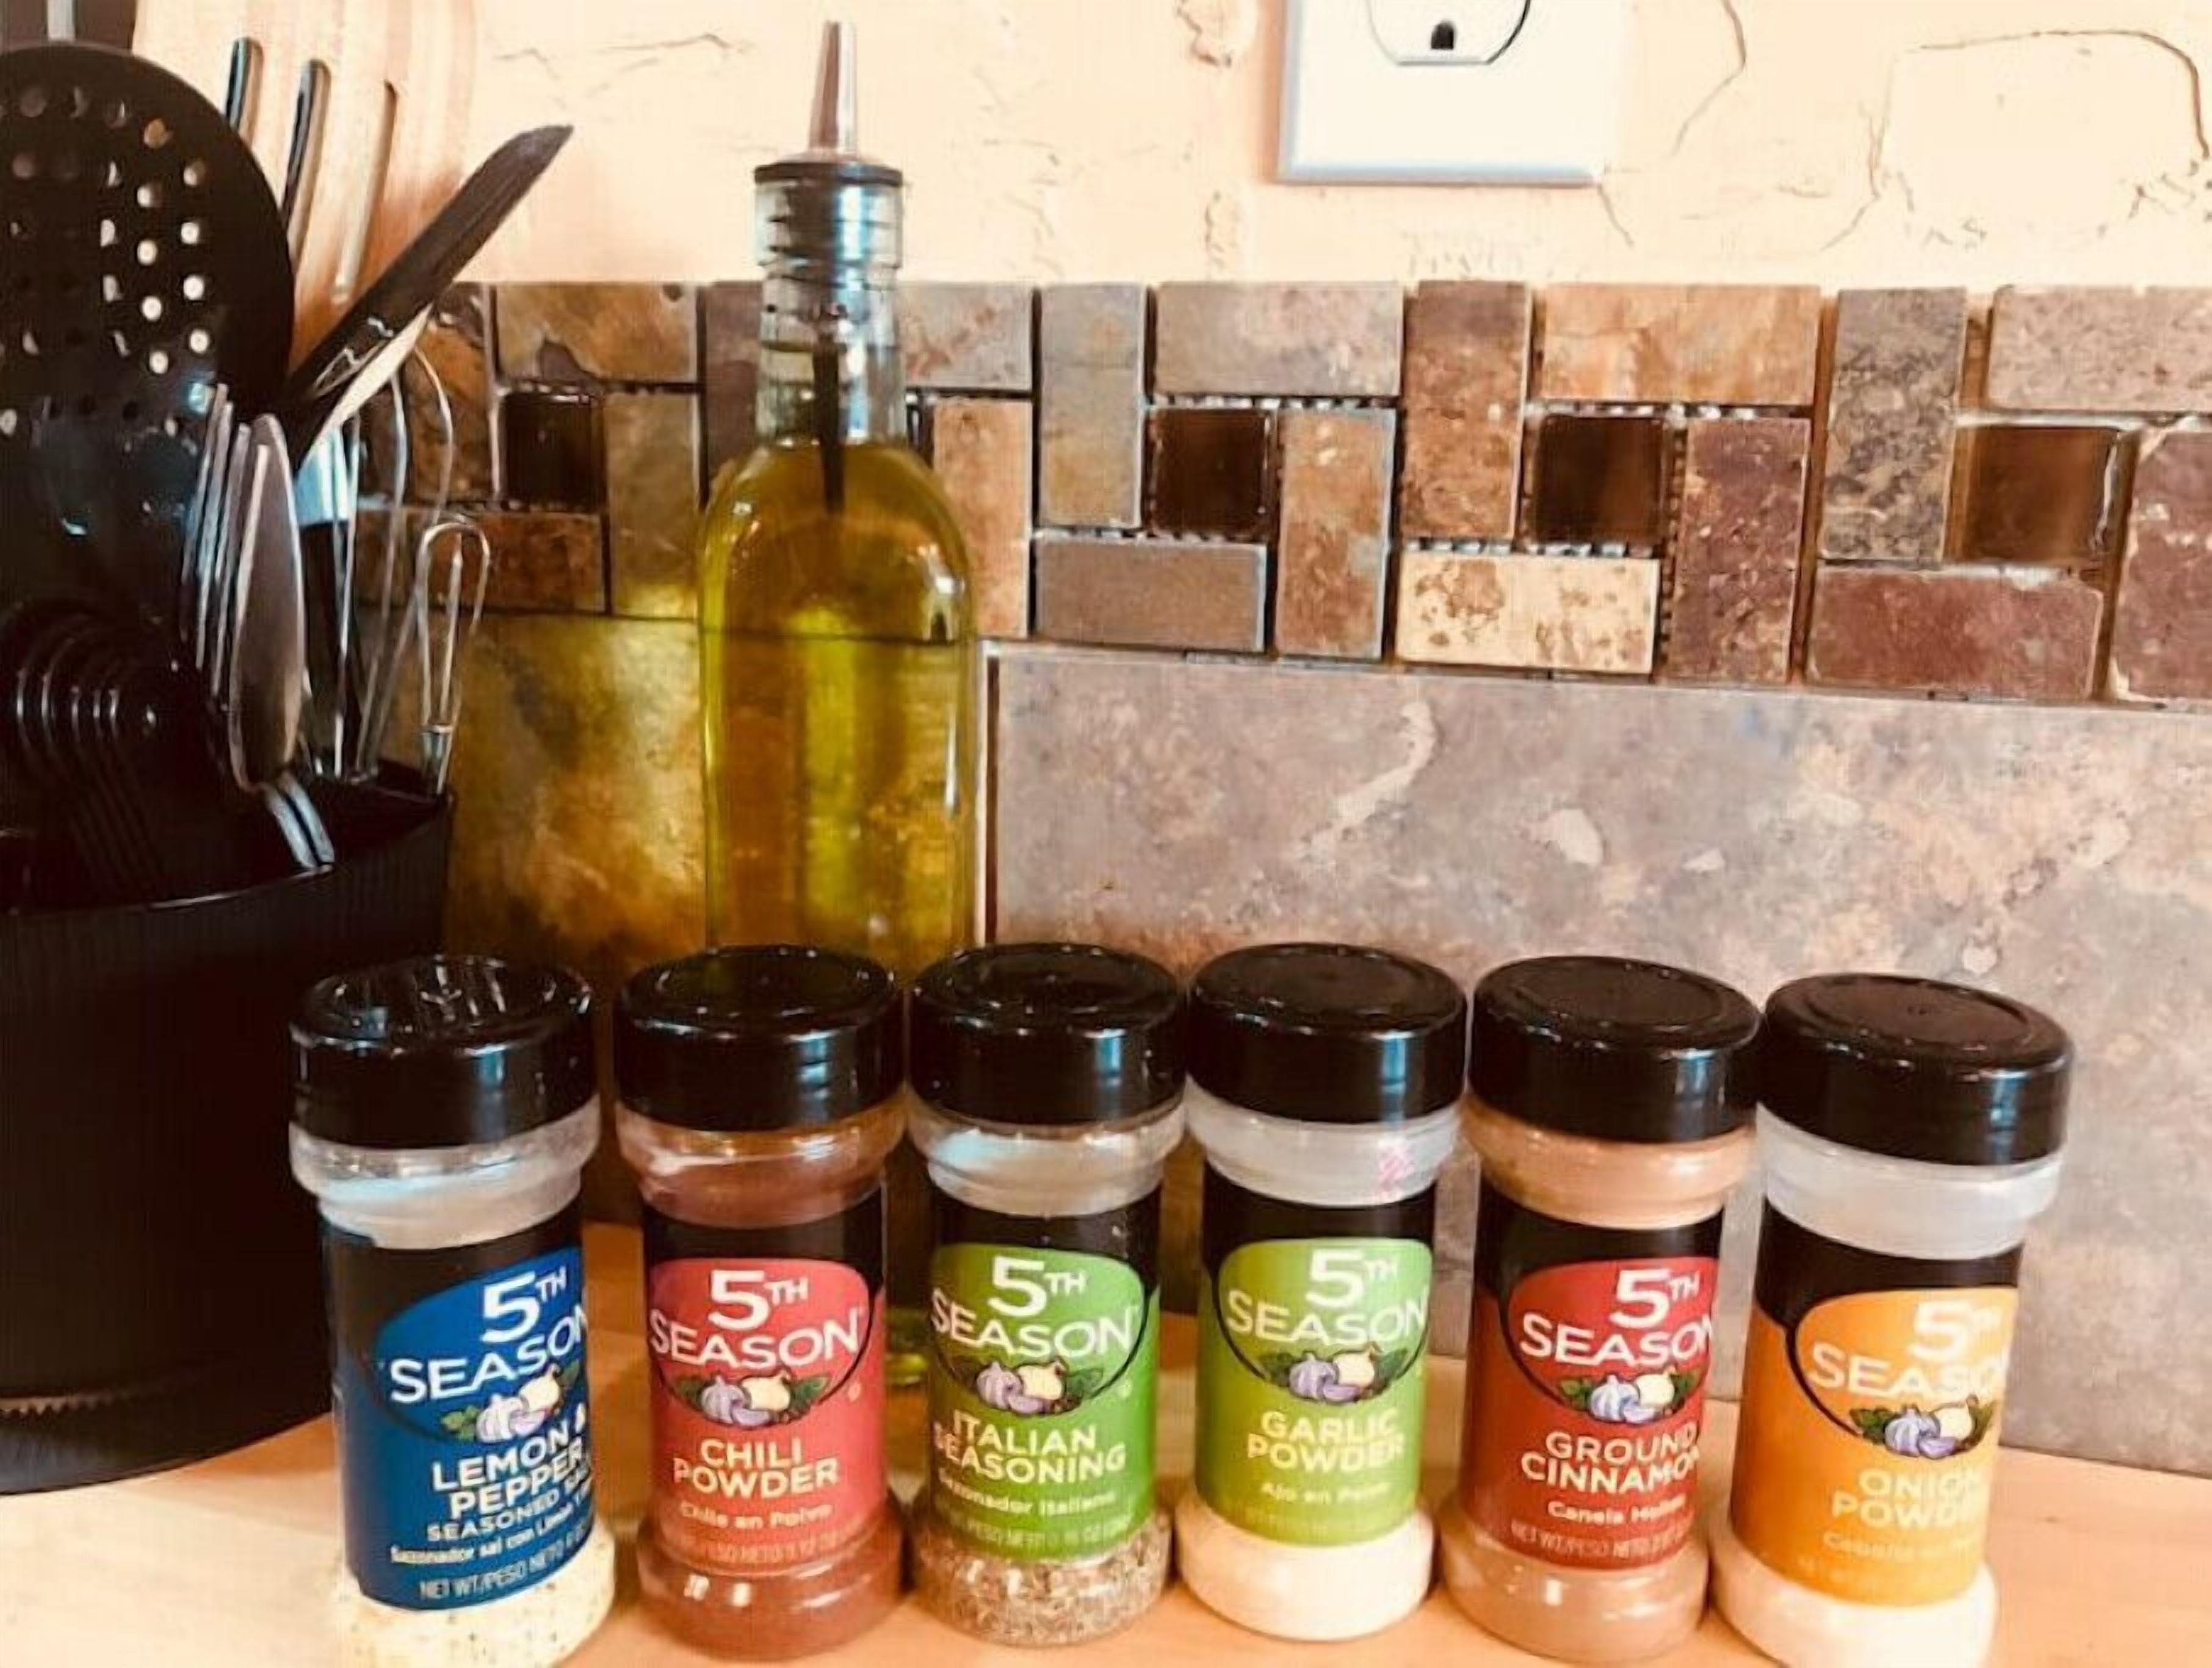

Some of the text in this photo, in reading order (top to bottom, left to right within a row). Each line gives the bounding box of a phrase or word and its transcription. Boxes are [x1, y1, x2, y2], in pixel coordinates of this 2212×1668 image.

[480, 1266, 567, 1343] 5TH
[708, 1270, 809, 1330] 5TH
[987, 1255, 1088, 1318] 5TH
[1227, 1285, 1429, 1346] SEASON
[1608, 1268, 1701, 1329] 5TH
[650, 1307, 859, 1369] SEASON
[931, 1288, 1133, 1358] SEASON
[432, 1419, 569, 1492] LEMON
[701, 1437, 802, 1469] CHILI
[953, 1409, 1097, 1457] ITALIAN
[1260, 1409, 1398, 1445] GARLIC
[1545, 1421, 1697, 1466] GROUND
[450, 1436, 583, 1520] PEPPER
[673, 1457, 840, 1499] POWDER
